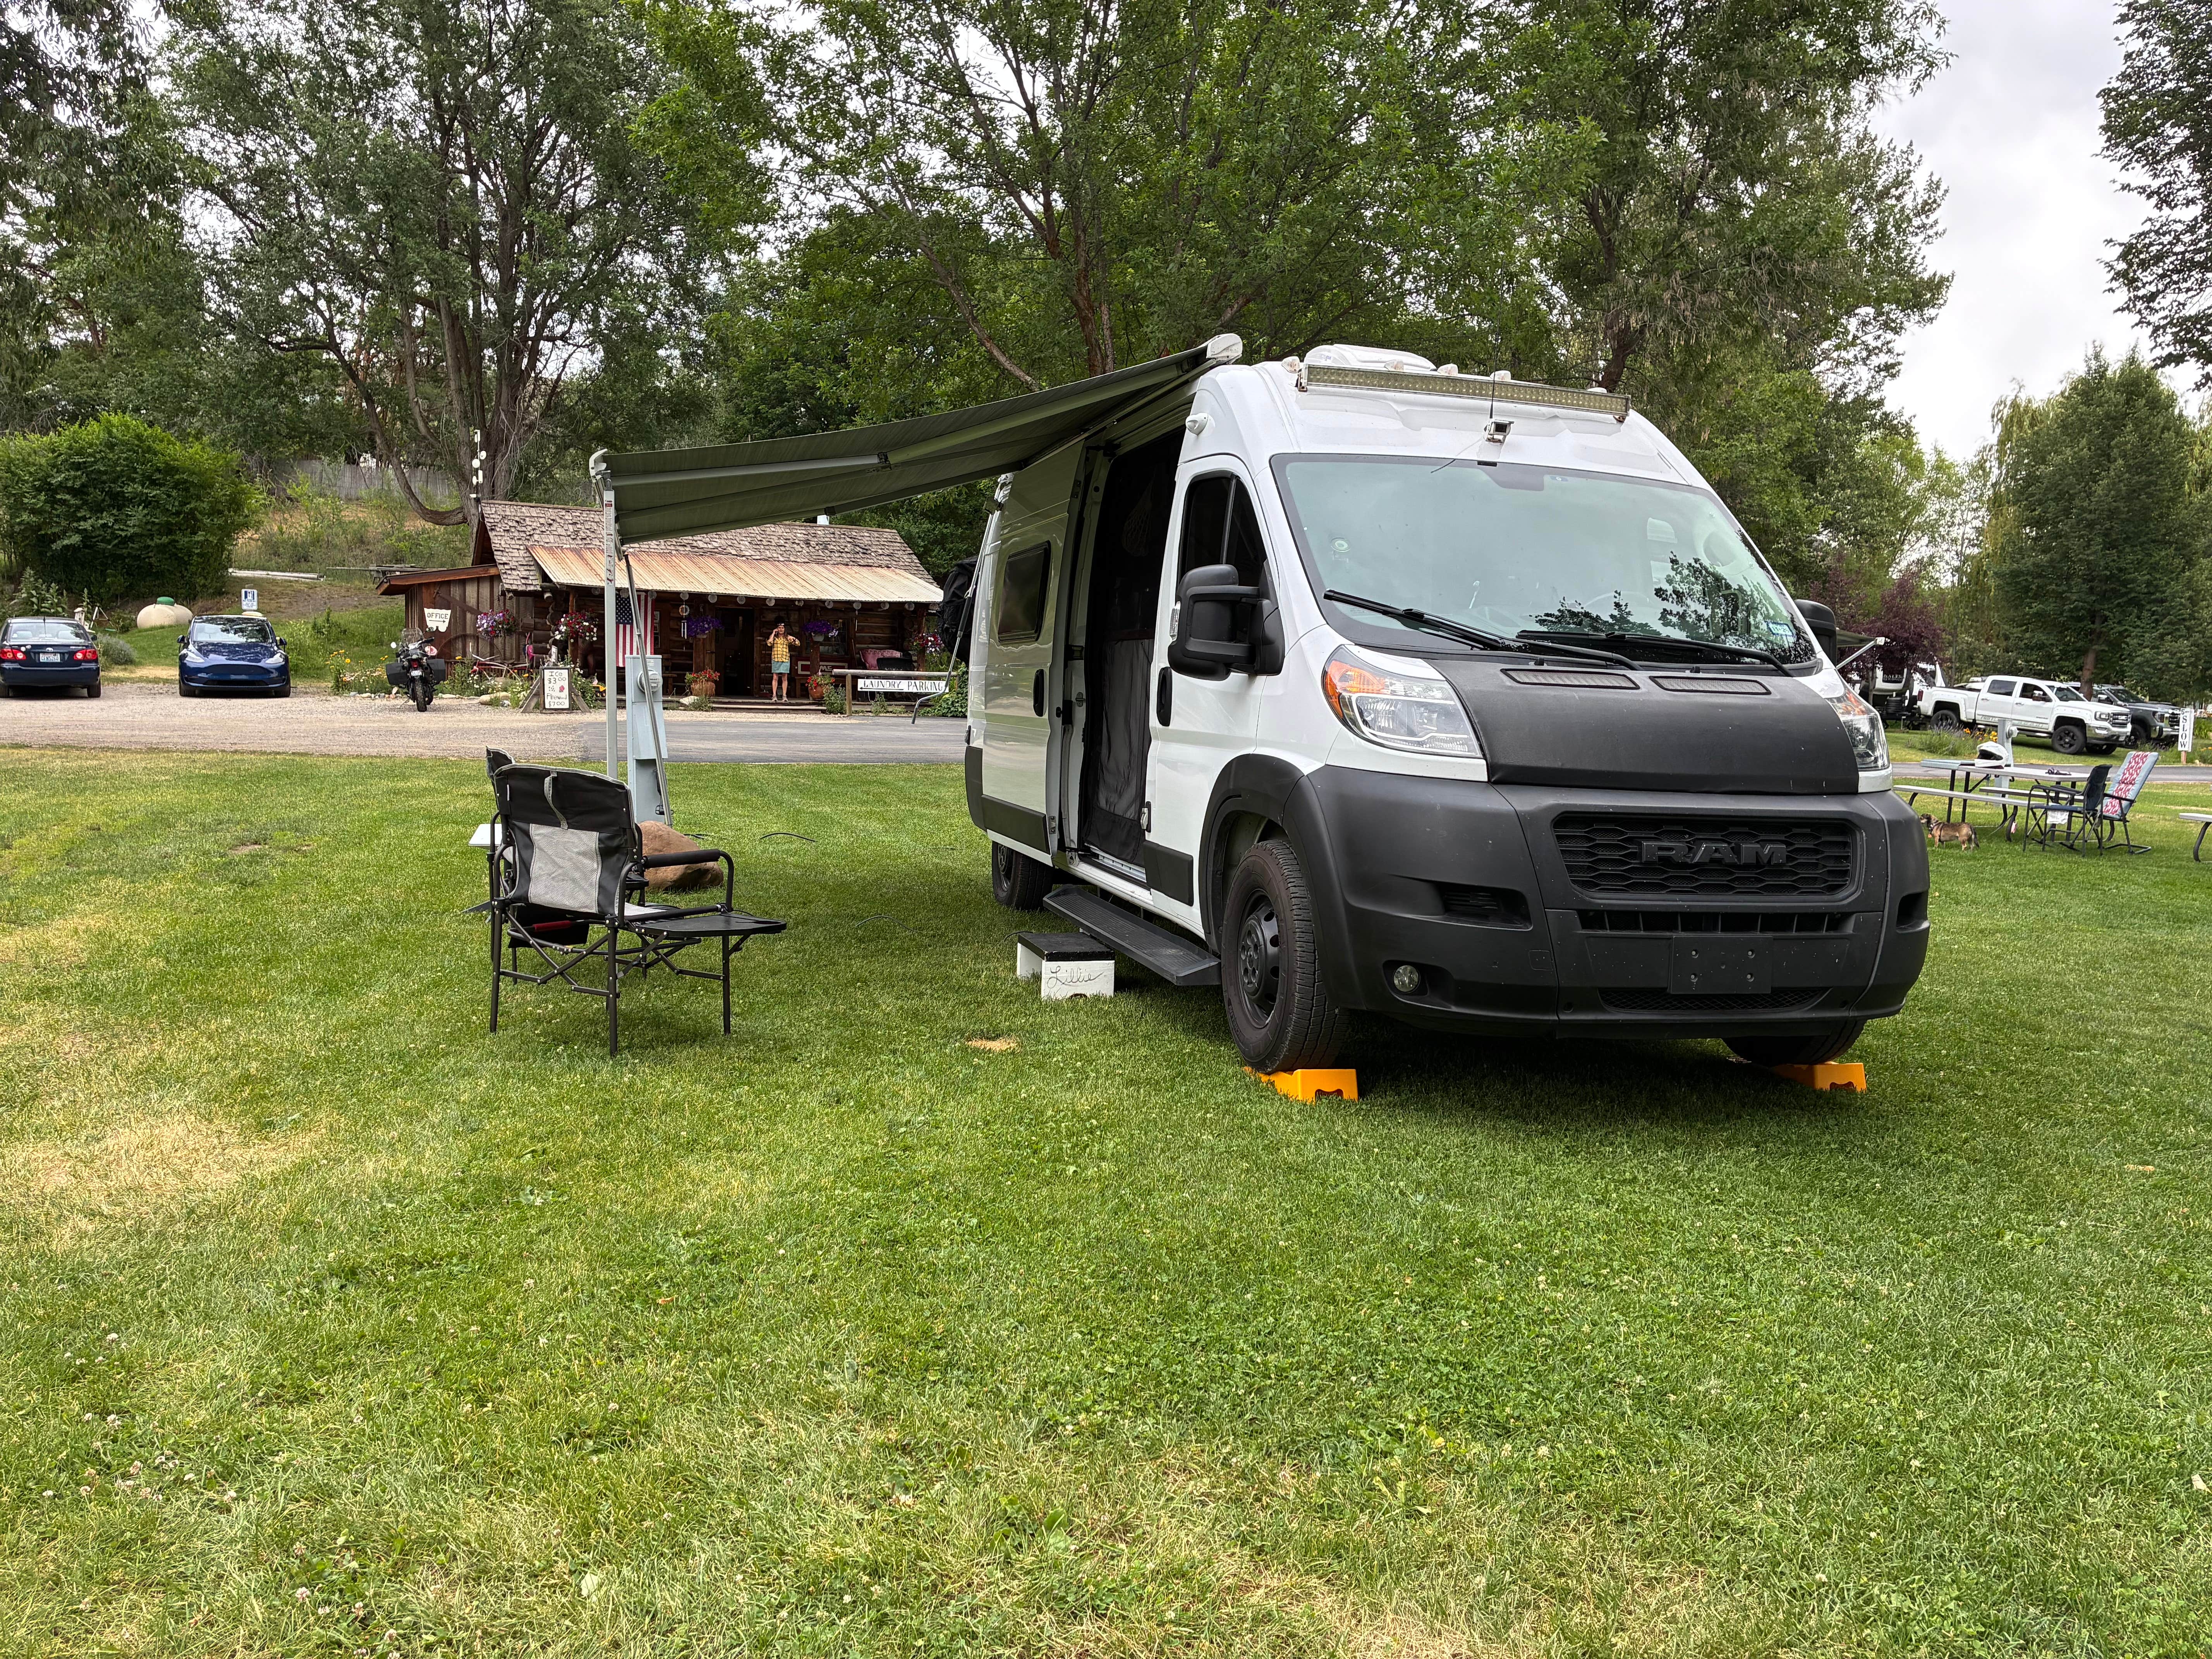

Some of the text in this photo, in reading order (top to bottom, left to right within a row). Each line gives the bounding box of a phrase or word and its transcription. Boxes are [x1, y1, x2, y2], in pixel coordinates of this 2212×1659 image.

[908, 681, 943, 691] PARKING
[1642, 841, 1787, 864] RAM
[1047, 965, 1104, 989] Lillie
